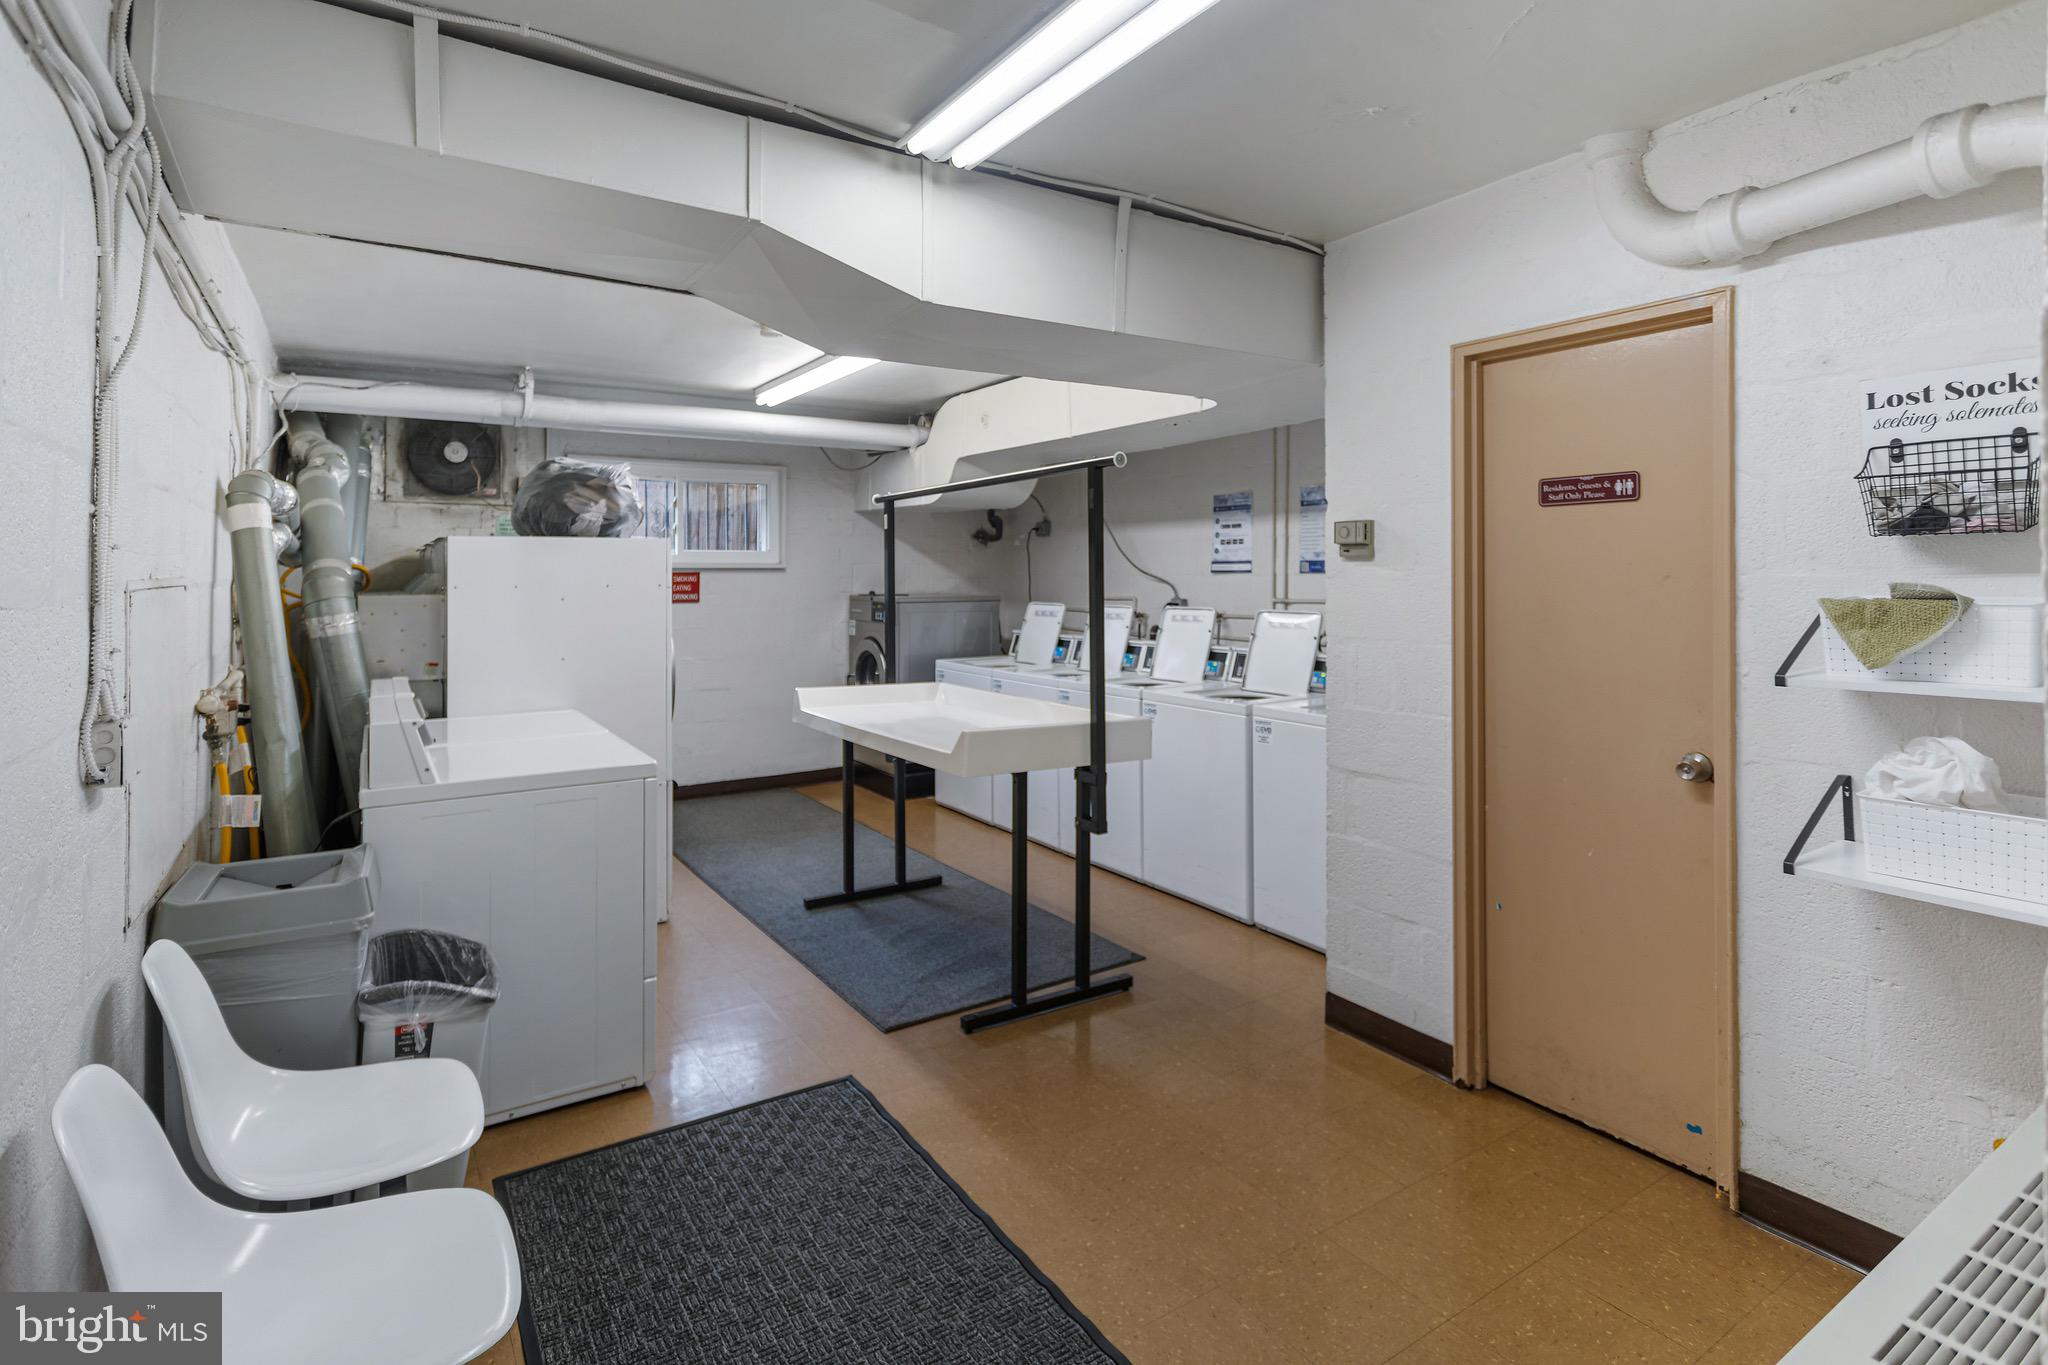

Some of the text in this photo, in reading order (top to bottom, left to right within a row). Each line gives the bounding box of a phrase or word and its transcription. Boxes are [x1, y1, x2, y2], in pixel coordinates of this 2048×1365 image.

[1866, 384, 1935, 410] Lost
[1873, 396, 2038, 433] seeking solemates
[1603, 480, 1611, 488] &
[1565, 492, 1581, 500] Only
[1583, 491, 1606, 499] Please
